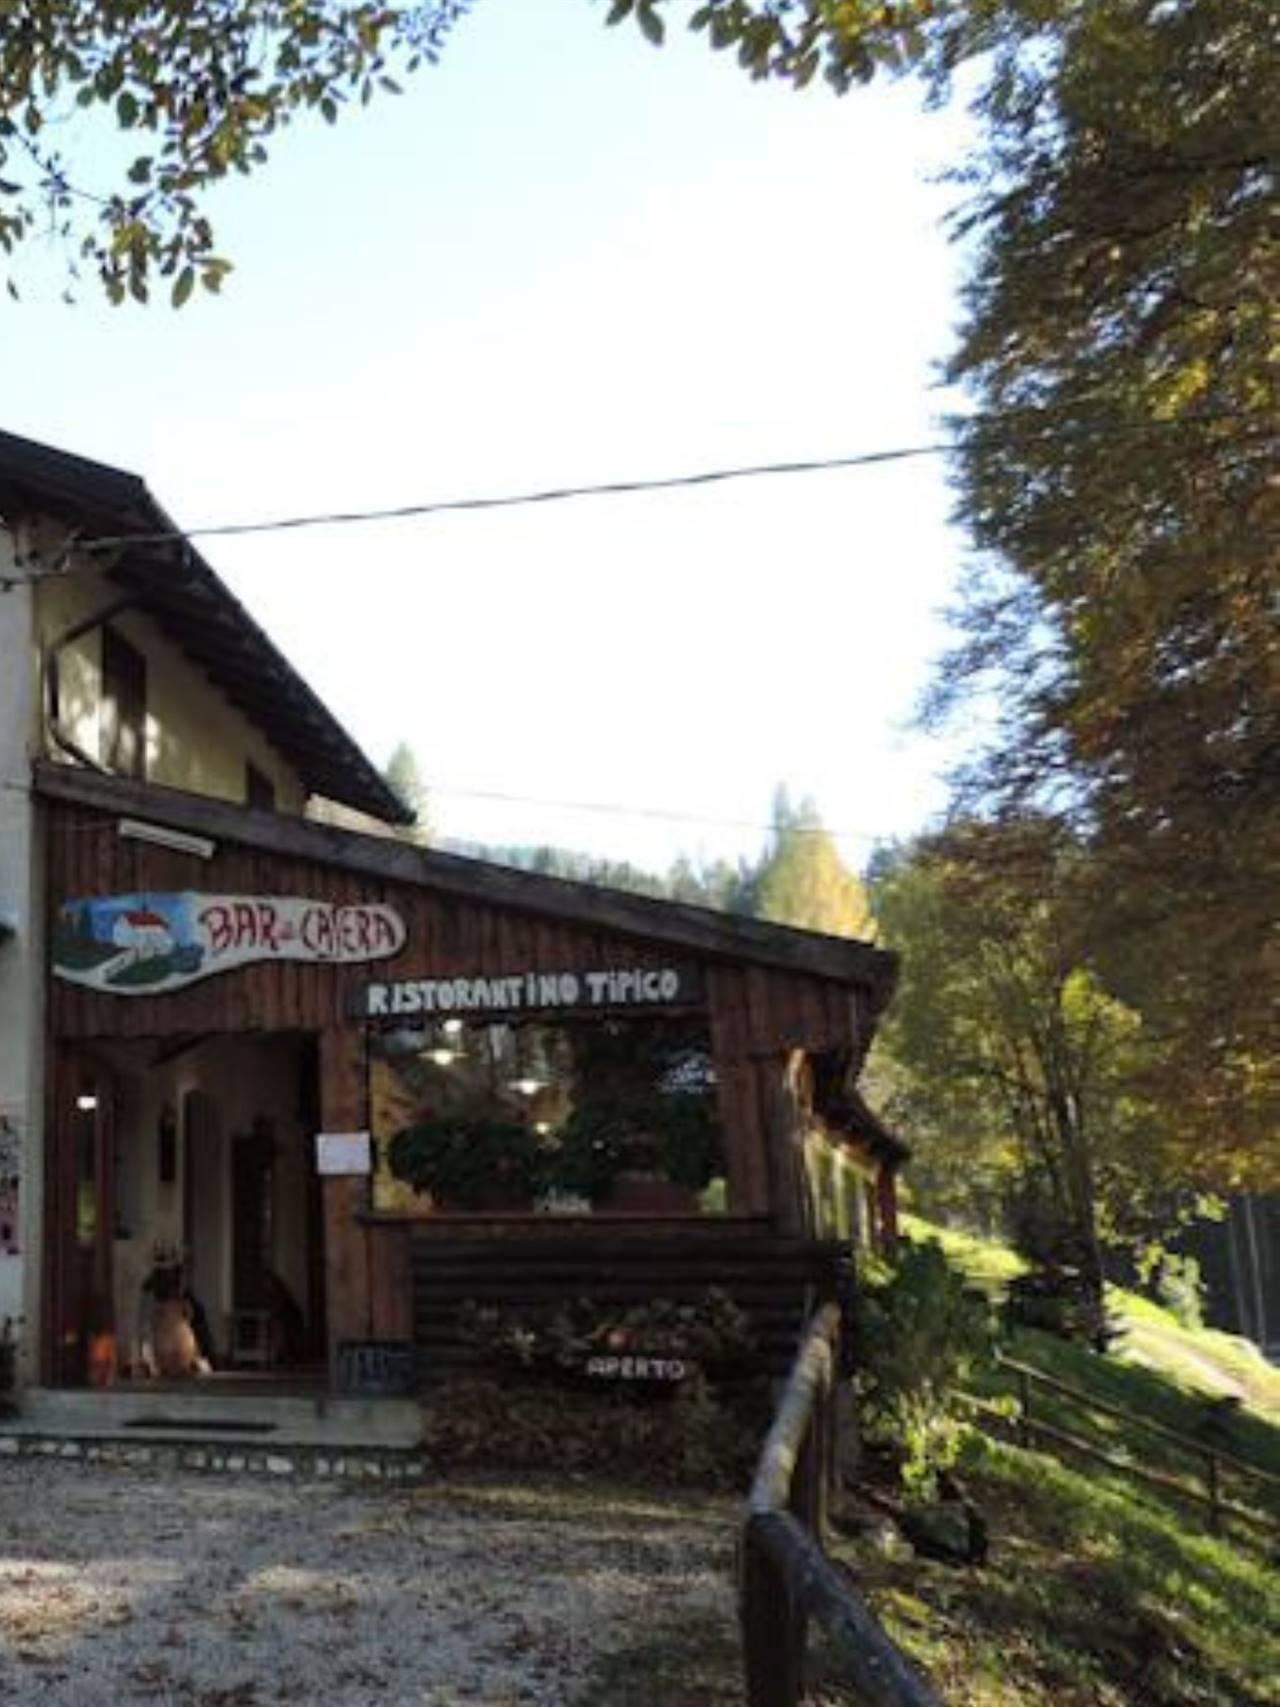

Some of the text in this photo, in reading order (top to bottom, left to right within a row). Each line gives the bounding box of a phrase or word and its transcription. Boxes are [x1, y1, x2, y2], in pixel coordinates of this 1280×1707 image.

[198, 902, 279, 952] BAR
[368, 970, 679, 1014] RISTORANTINO TIPICO
[587, 1357, 685, 1380] APERTO
